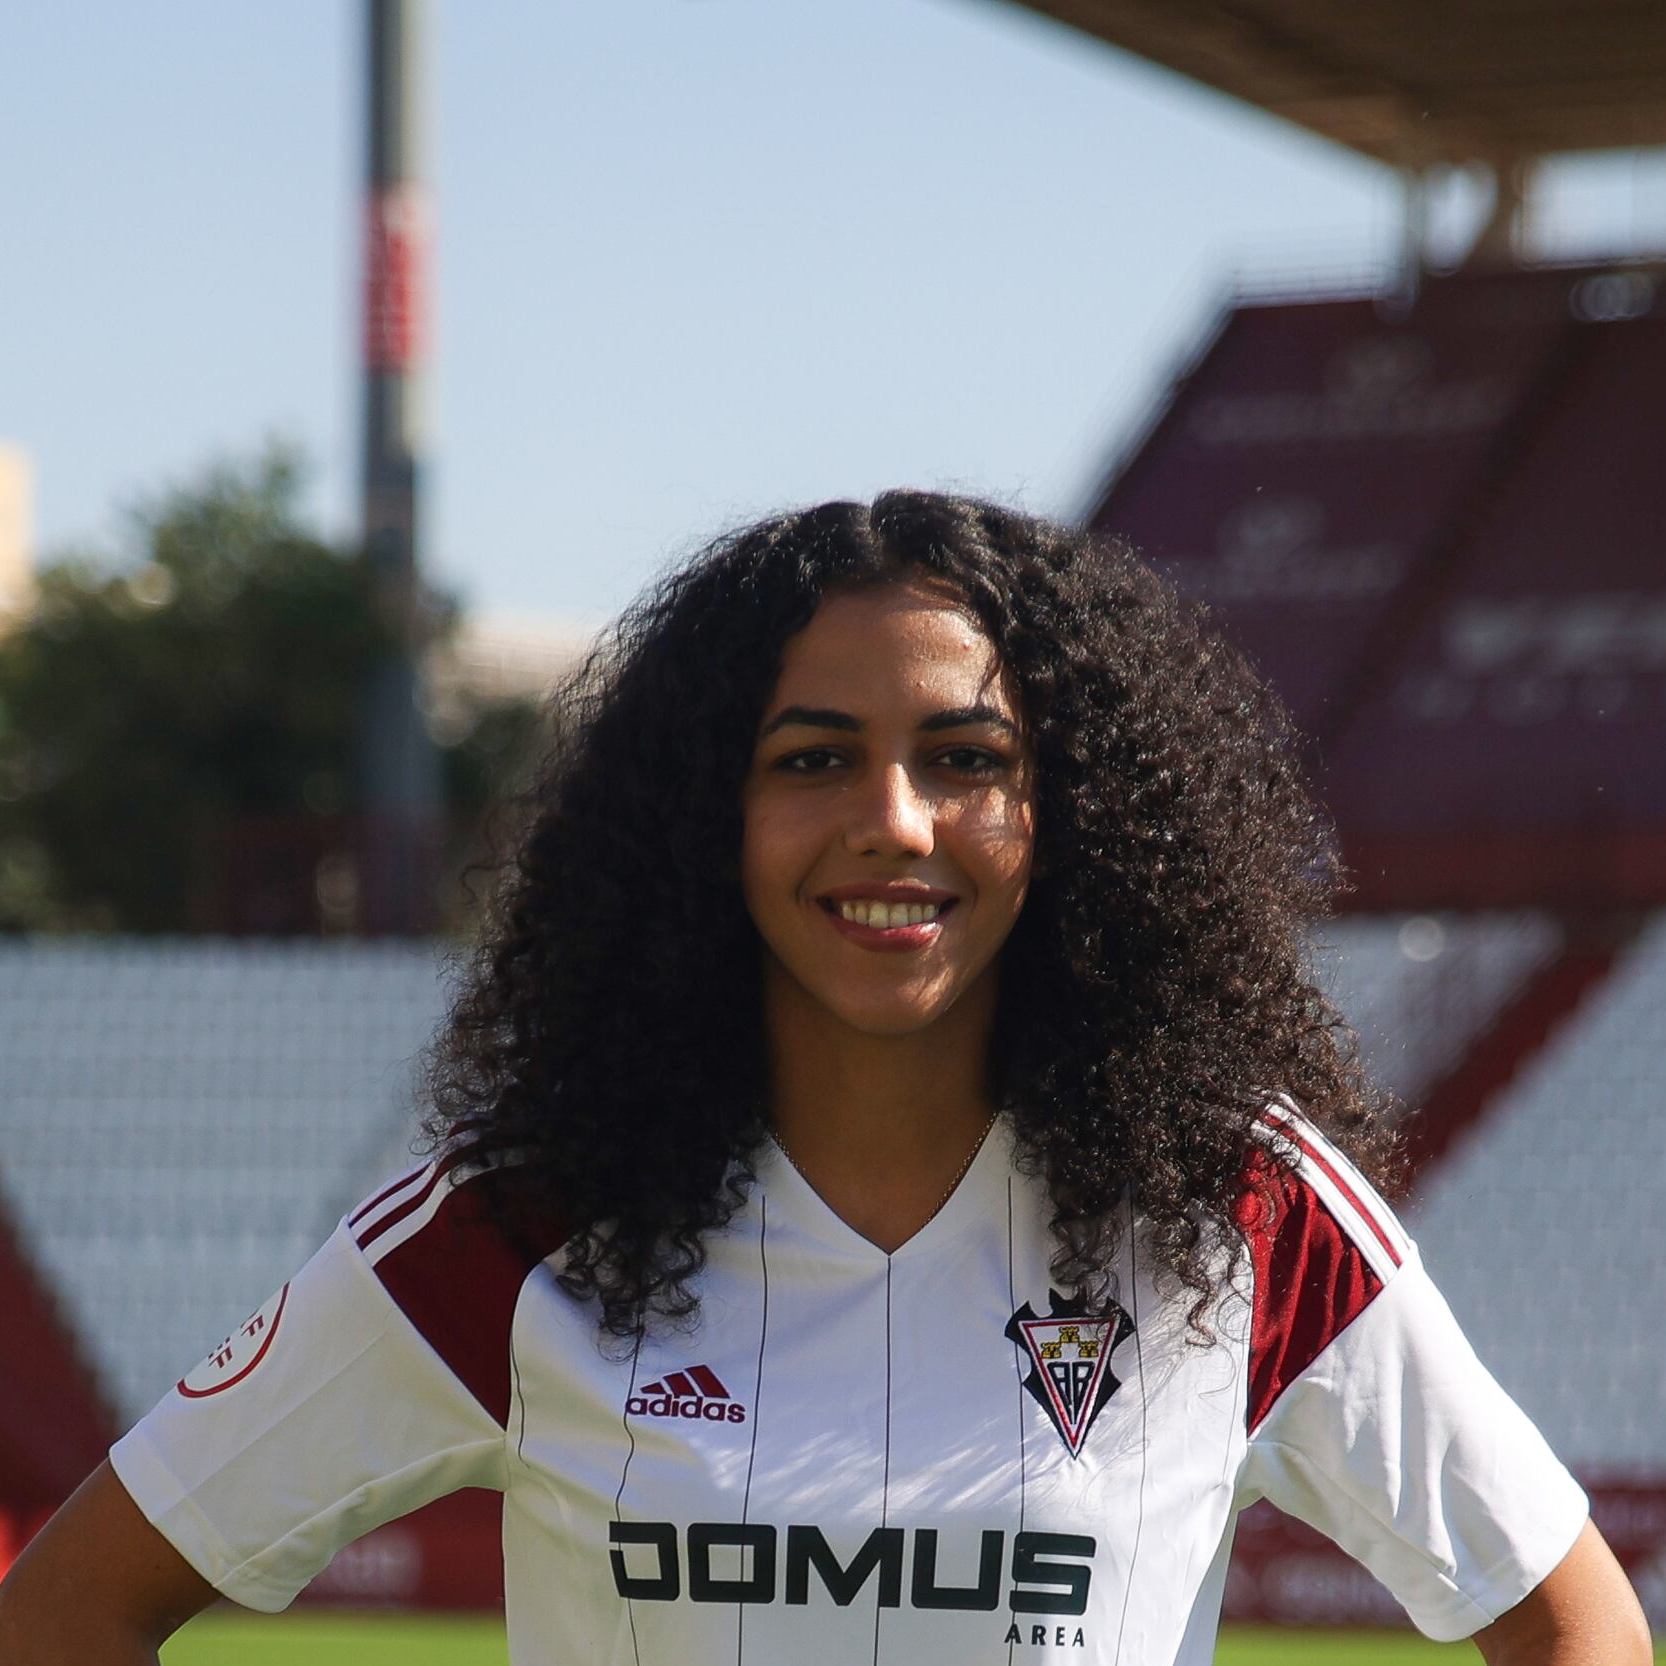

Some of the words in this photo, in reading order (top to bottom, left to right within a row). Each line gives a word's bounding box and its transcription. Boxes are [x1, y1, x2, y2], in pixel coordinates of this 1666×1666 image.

[626, 1394, 746, 1424] adidas
[609, 1520, 1097, 1616] DOMUS
[1004, 1623, 1085, 1648] AREA
